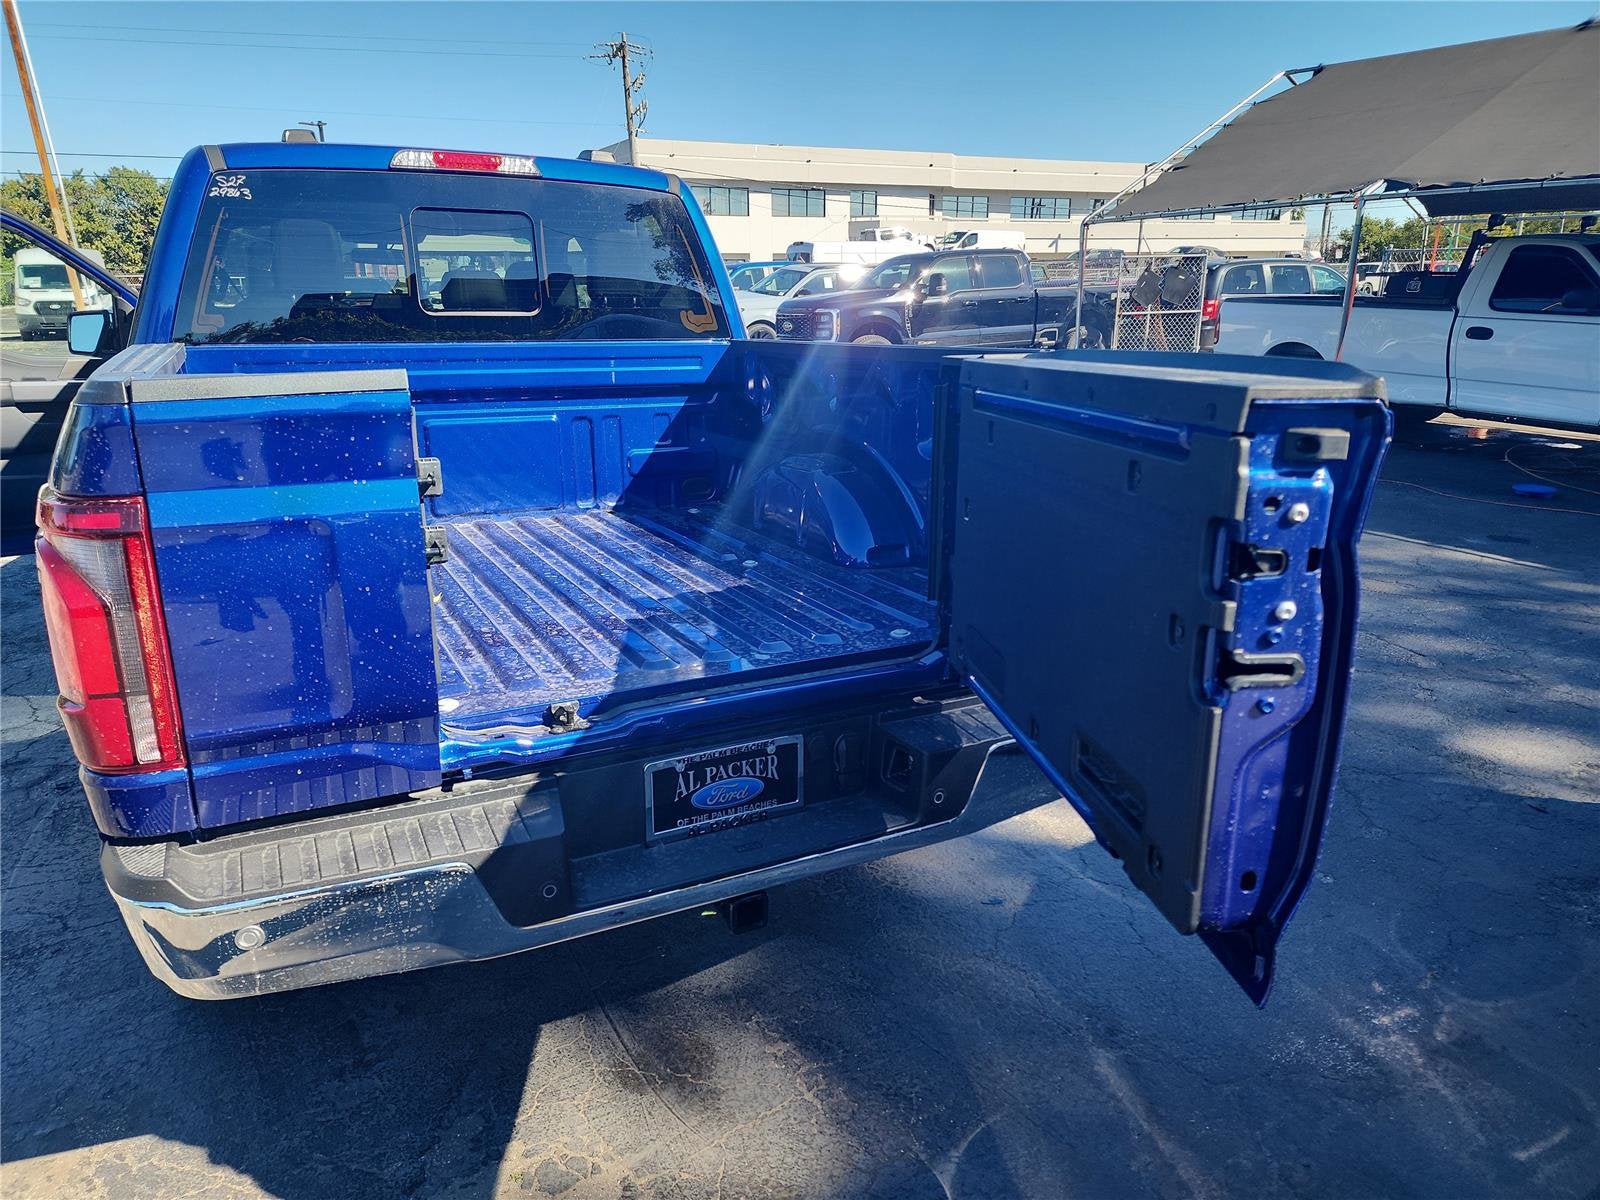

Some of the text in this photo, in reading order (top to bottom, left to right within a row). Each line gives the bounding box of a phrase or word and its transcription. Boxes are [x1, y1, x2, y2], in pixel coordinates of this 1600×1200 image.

[215, 175, 246, 187] S27
[674, 754, 780, 802] AL PACKER
[706, 783, 750, 805] Ford
[676, 798, 777, 828] OF THE PALM BEACHES
